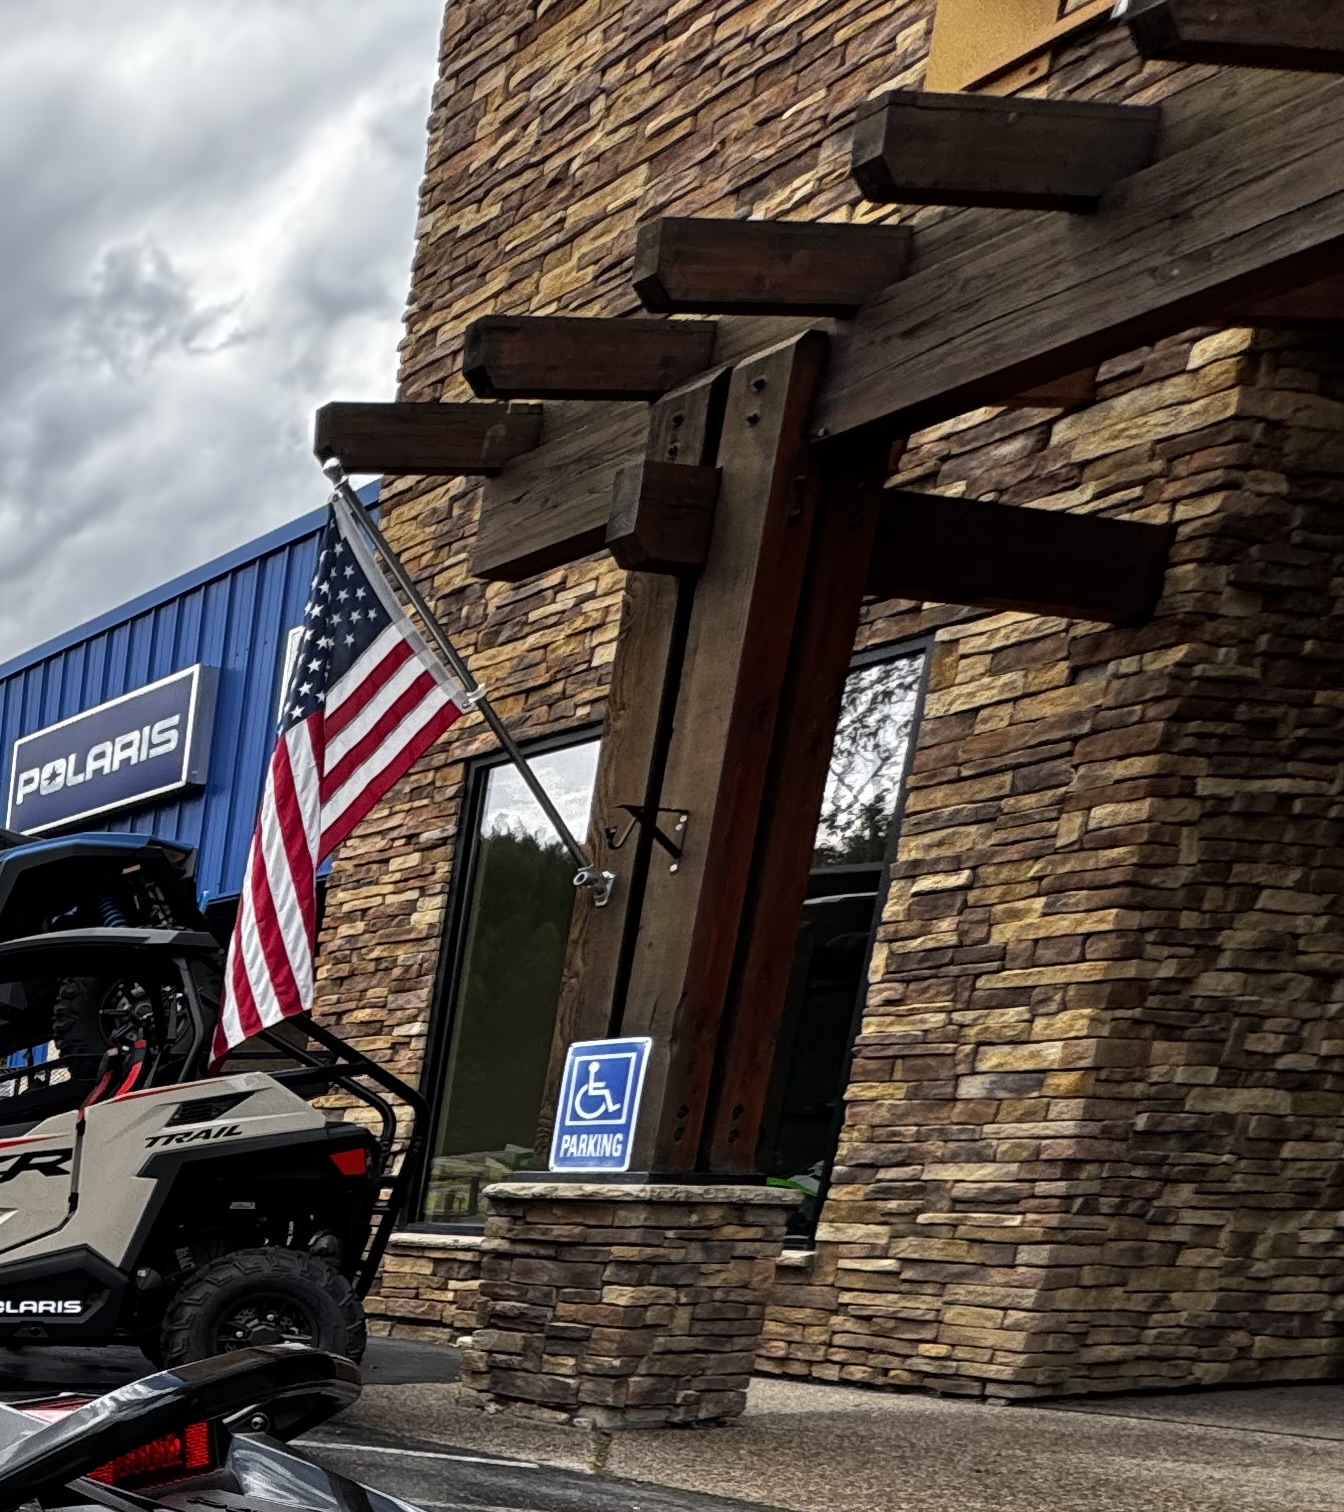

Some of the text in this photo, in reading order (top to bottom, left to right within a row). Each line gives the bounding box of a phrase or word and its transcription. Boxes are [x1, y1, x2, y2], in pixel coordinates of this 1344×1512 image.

[15, 713, 181, 806] POLARIS
[145, 1124, 243, 1149] TRAIL
[559, 1133, 624, 1158] PARKING
